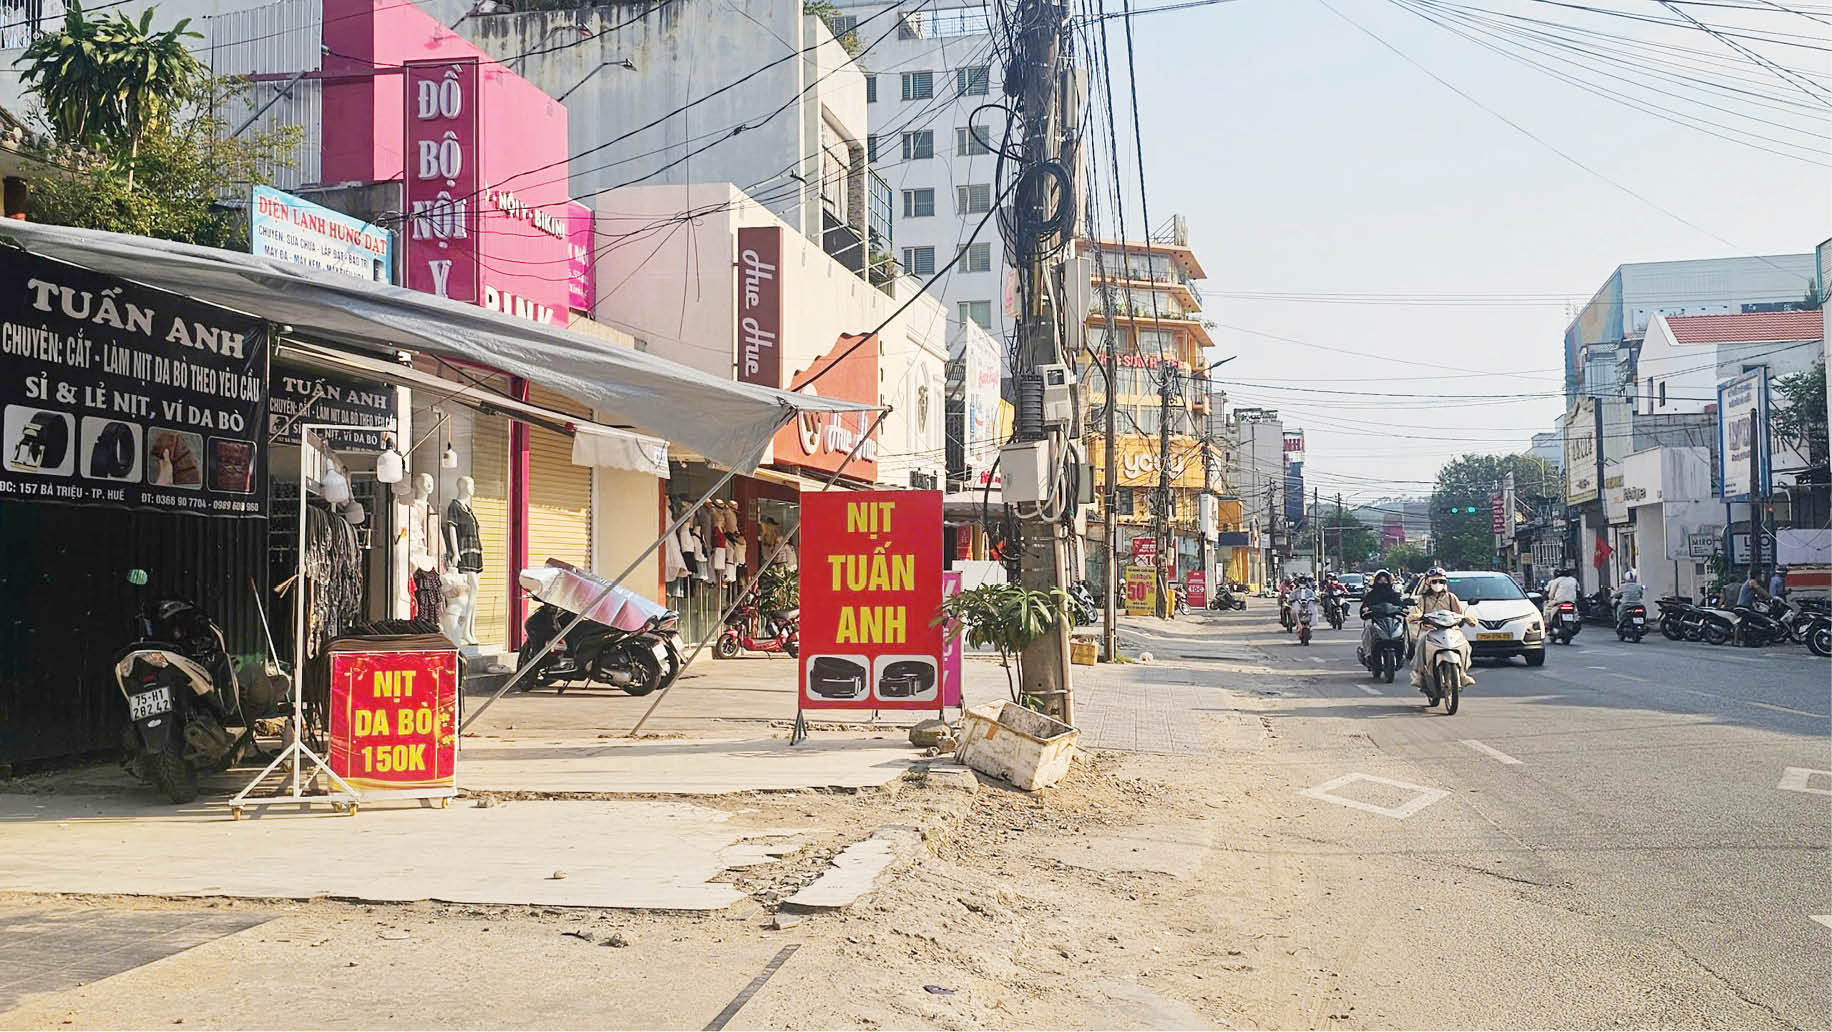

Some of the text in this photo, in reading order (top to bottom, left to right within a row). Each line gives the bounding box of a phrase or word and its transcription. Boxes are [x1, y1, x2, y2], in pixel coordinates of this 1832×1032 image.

[417, 64, 464, 120] ĐỒ
[417, 130, 464, 188] BỘ
[293, 208, 326, 235] LẠNH
[411, 190, 470, 248] NỘI
[27, 277, 245, 360] TUẤN ANH
[2, 320, 63, 365] CHUYÊN:
[66, 329, 91, 369] CẮT
[103, 339, 131, 377] LÀM
[132, 349, 154, 388] NỊT
[154, 355, 172, 386] DA
[173, 355, 188, 390] BÒ
[190, 365, 217, 397] THEO
[218, 368, 239, 399] YÊU
[240, 368, 260, 403] CẦU
[25, 371, 245, 432] SỈ & LẺ NỊT, VÍ DA BÒ
[282, 376, 387, 410] TUẤN ANH
[19, 482, 38, 495] 157
[40, 483, 55, 497] BÀ
[56, 485, 83, 500] TRIỆU
[91, 488, 106, 500] TP.
[141, 493, 155, 505] ĐT:
[847, 501, 896, 540] NỊT
[828, 541, 915, 592] TUẤN
[835, 606, 906, 644] ANH
[135, 689, 164, 706] 75-H1
[373, 671, 417, 703] NỊT
[354, 702, 433, 737] DA BÒ
[361, 743, 427, 773] 150K
